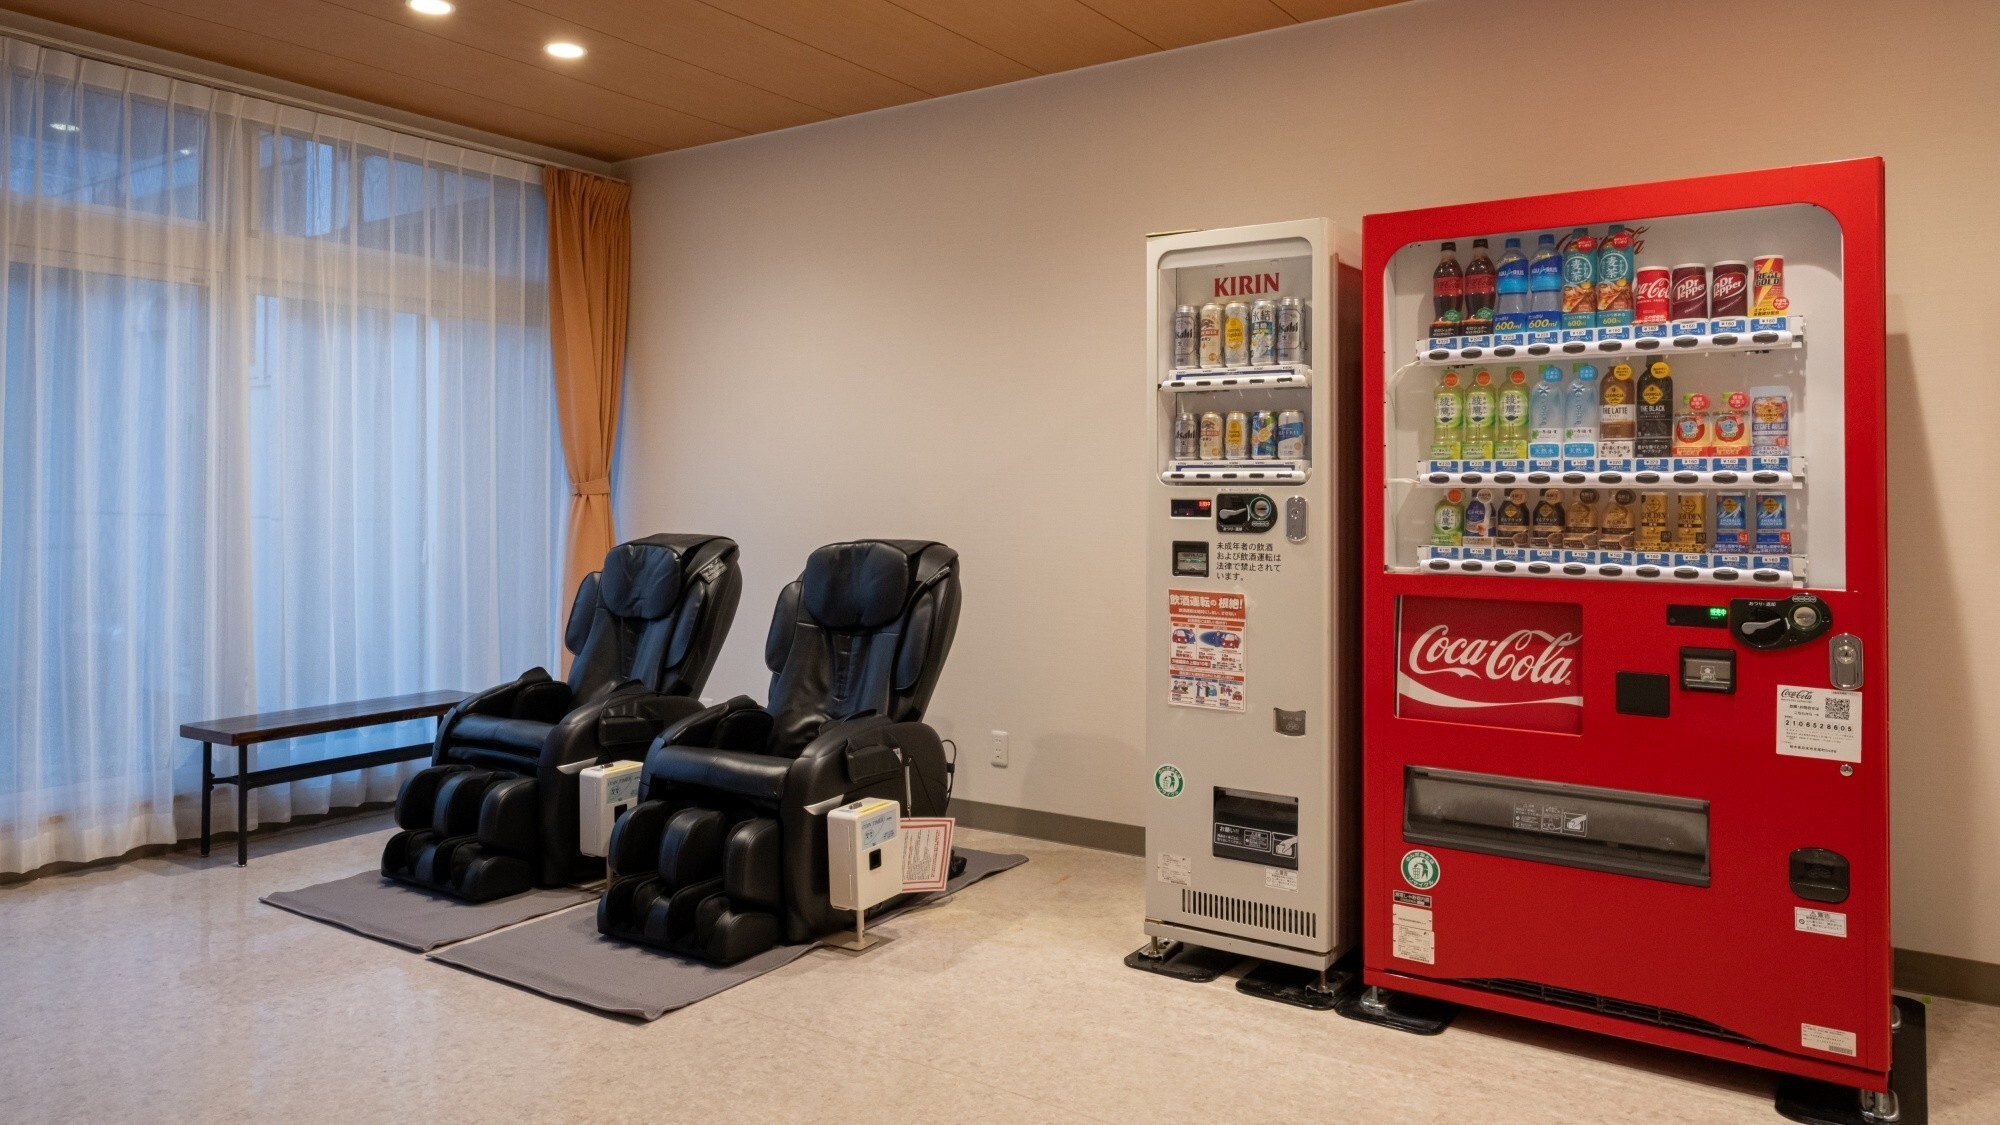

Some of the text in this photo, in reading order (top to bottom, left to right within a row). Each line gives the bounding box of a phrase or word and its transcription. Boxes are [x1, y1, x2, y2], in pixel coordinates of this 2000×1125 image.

[1571, 259, 1582, 282] 麦茶
[1606, 256, 1618, 278] 麦茶
[1214, 272, 1280, 298] KIRIN
[1685, 279, 1699, 288] Dr
[1720, 276, 1733, 287] Dr
[1756, 278, 1779, 286] GOLD
[1677, 284, 1705, 300] Pepper
[1713, 280, 1742, 298] Pepper
[1496, 321, 1522, 331] 600ml
[1528, 319, 1558, 328] 600ml
[1216, 542, 1273, 551] 未成年者の飲酒
[1217, 552, 1282, 562] および飲酒運転は
[1217, 562, 1282, 572] 法律で禁止されて
[1217, 572, 1244, 582] います。
[1409, 624, 1583, 684] Coca-Cola
[1781, 688, 1814, 700] Coca-Cola
